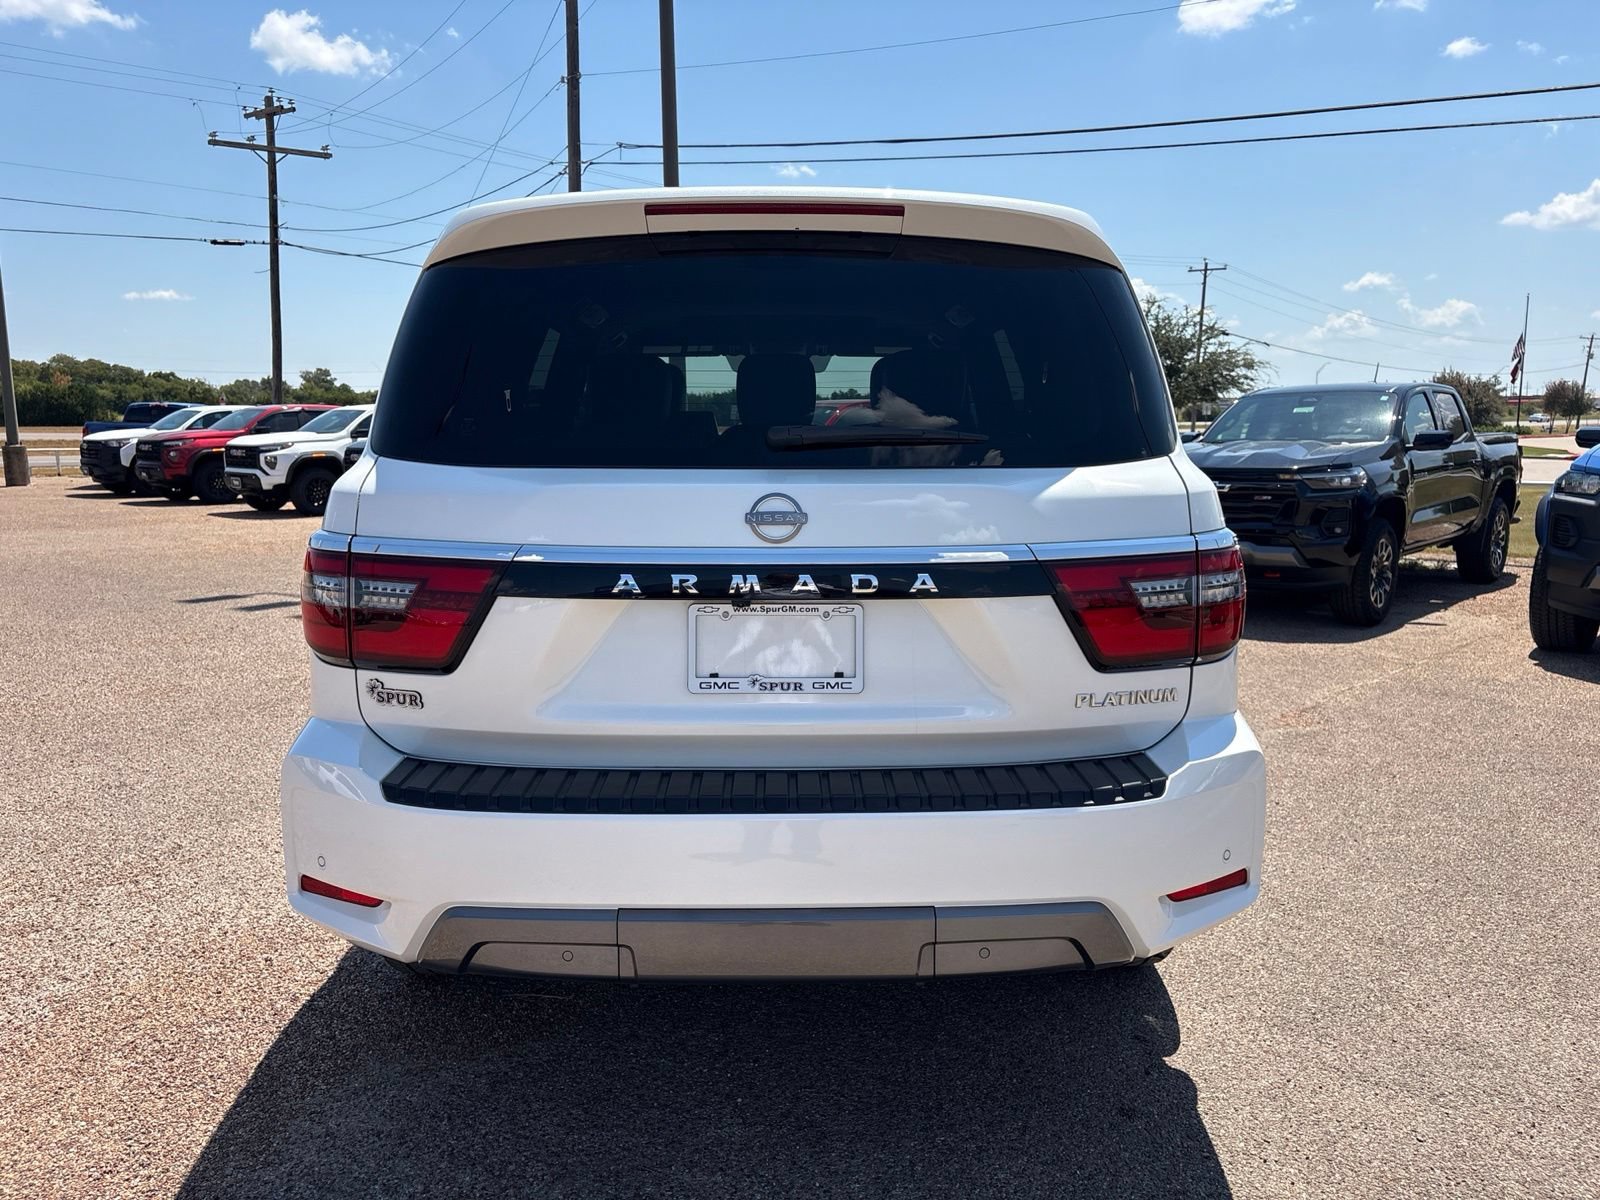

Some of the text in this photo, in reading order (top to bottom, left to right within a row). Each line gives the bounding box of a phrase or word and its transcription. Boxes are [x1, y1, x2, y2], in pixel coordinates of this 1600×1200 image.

[746, 514, 806, 522] NISSAN
[611, 573, 939, 594] ARMADA
[733, 605, 819, 614] www.SpurGM.com
[699, 681, 853, 691] GMC SPUR GMC
[376, 690, 419, 707] SPUR
[1075, 687, 1178, 708] PLATINUM
